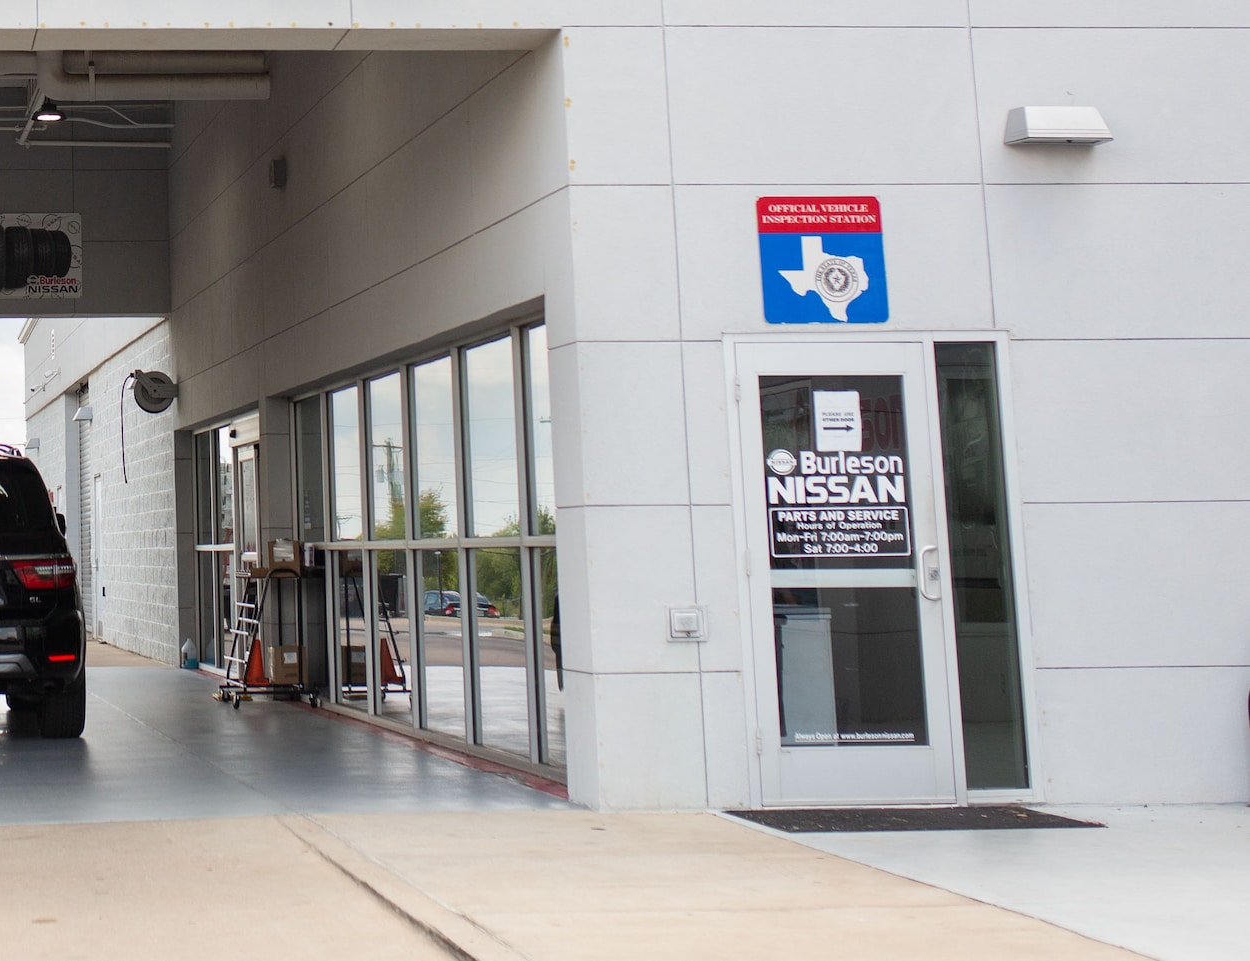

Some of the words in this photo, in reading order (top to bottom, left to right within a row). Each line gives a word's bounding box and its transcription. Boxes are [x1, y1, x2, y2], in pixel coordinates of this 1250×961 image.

[768, 204, 819, 213] OFFICIAL
[821, 204, 869, 213] VEHICLE
[762, 215, 828, 224] INSPECTION
[829, 215, 876, 224] STATION
[39, 276, 77, 285] Burleson
[28, 285, 78, 294] NISSAN
[800, 450, 904, 475] Burleson
[767, 475, 906, 505] NISSAN
[778, 511, 817, 521] PARTS
[819, 511, 845, 521] AND
[847, 510, 899, 521] SERVICE
[796, 522, 823, 530] Hours
[826, 522, 836, 530] of
[839, 522, 883, 531] Operation
[776, 532, 818, 542] Mon-Fri
[820, 531, 904, 543] 7:00am-7:00pm
[804, 543, 823, 553] Sat
[826, 543, 879, 553] 7:00-4:00
[815, 732, 832, 740] Open
